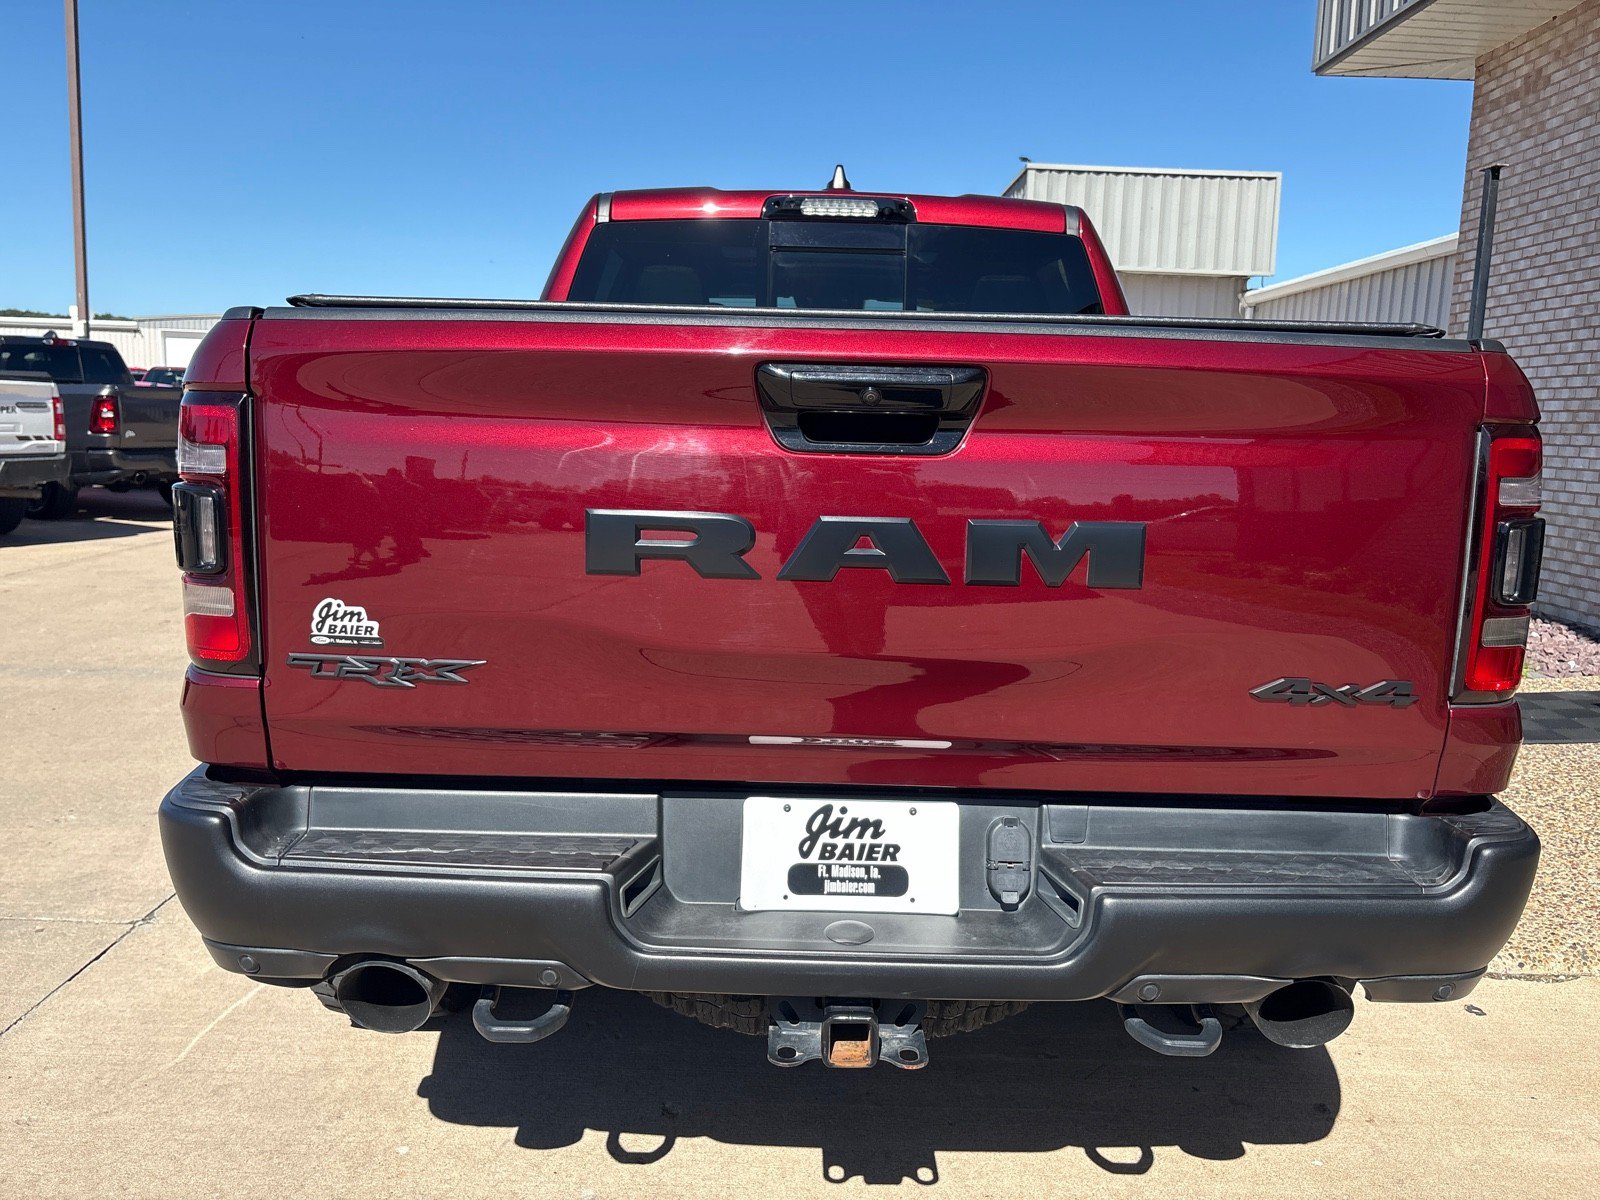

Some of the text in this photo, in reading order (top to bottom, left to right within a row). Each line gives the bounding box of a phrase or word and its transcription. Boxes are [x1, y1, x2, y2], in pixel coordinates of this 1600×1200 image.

[0, 405, 17, 414] PER
[585, 508, 1146, 589] RAM
[316, 602, 364, 632] Jim
[328, 624, 374, 635] BAIER
[798, 804, 886, 859] Jim
[818, 842, 901, 862] BAIER
[818, 864, 829, 878] Ft.
[831, 865, 867, 880] Madison,
[824, 880, 876, 894] jimbaier.com
